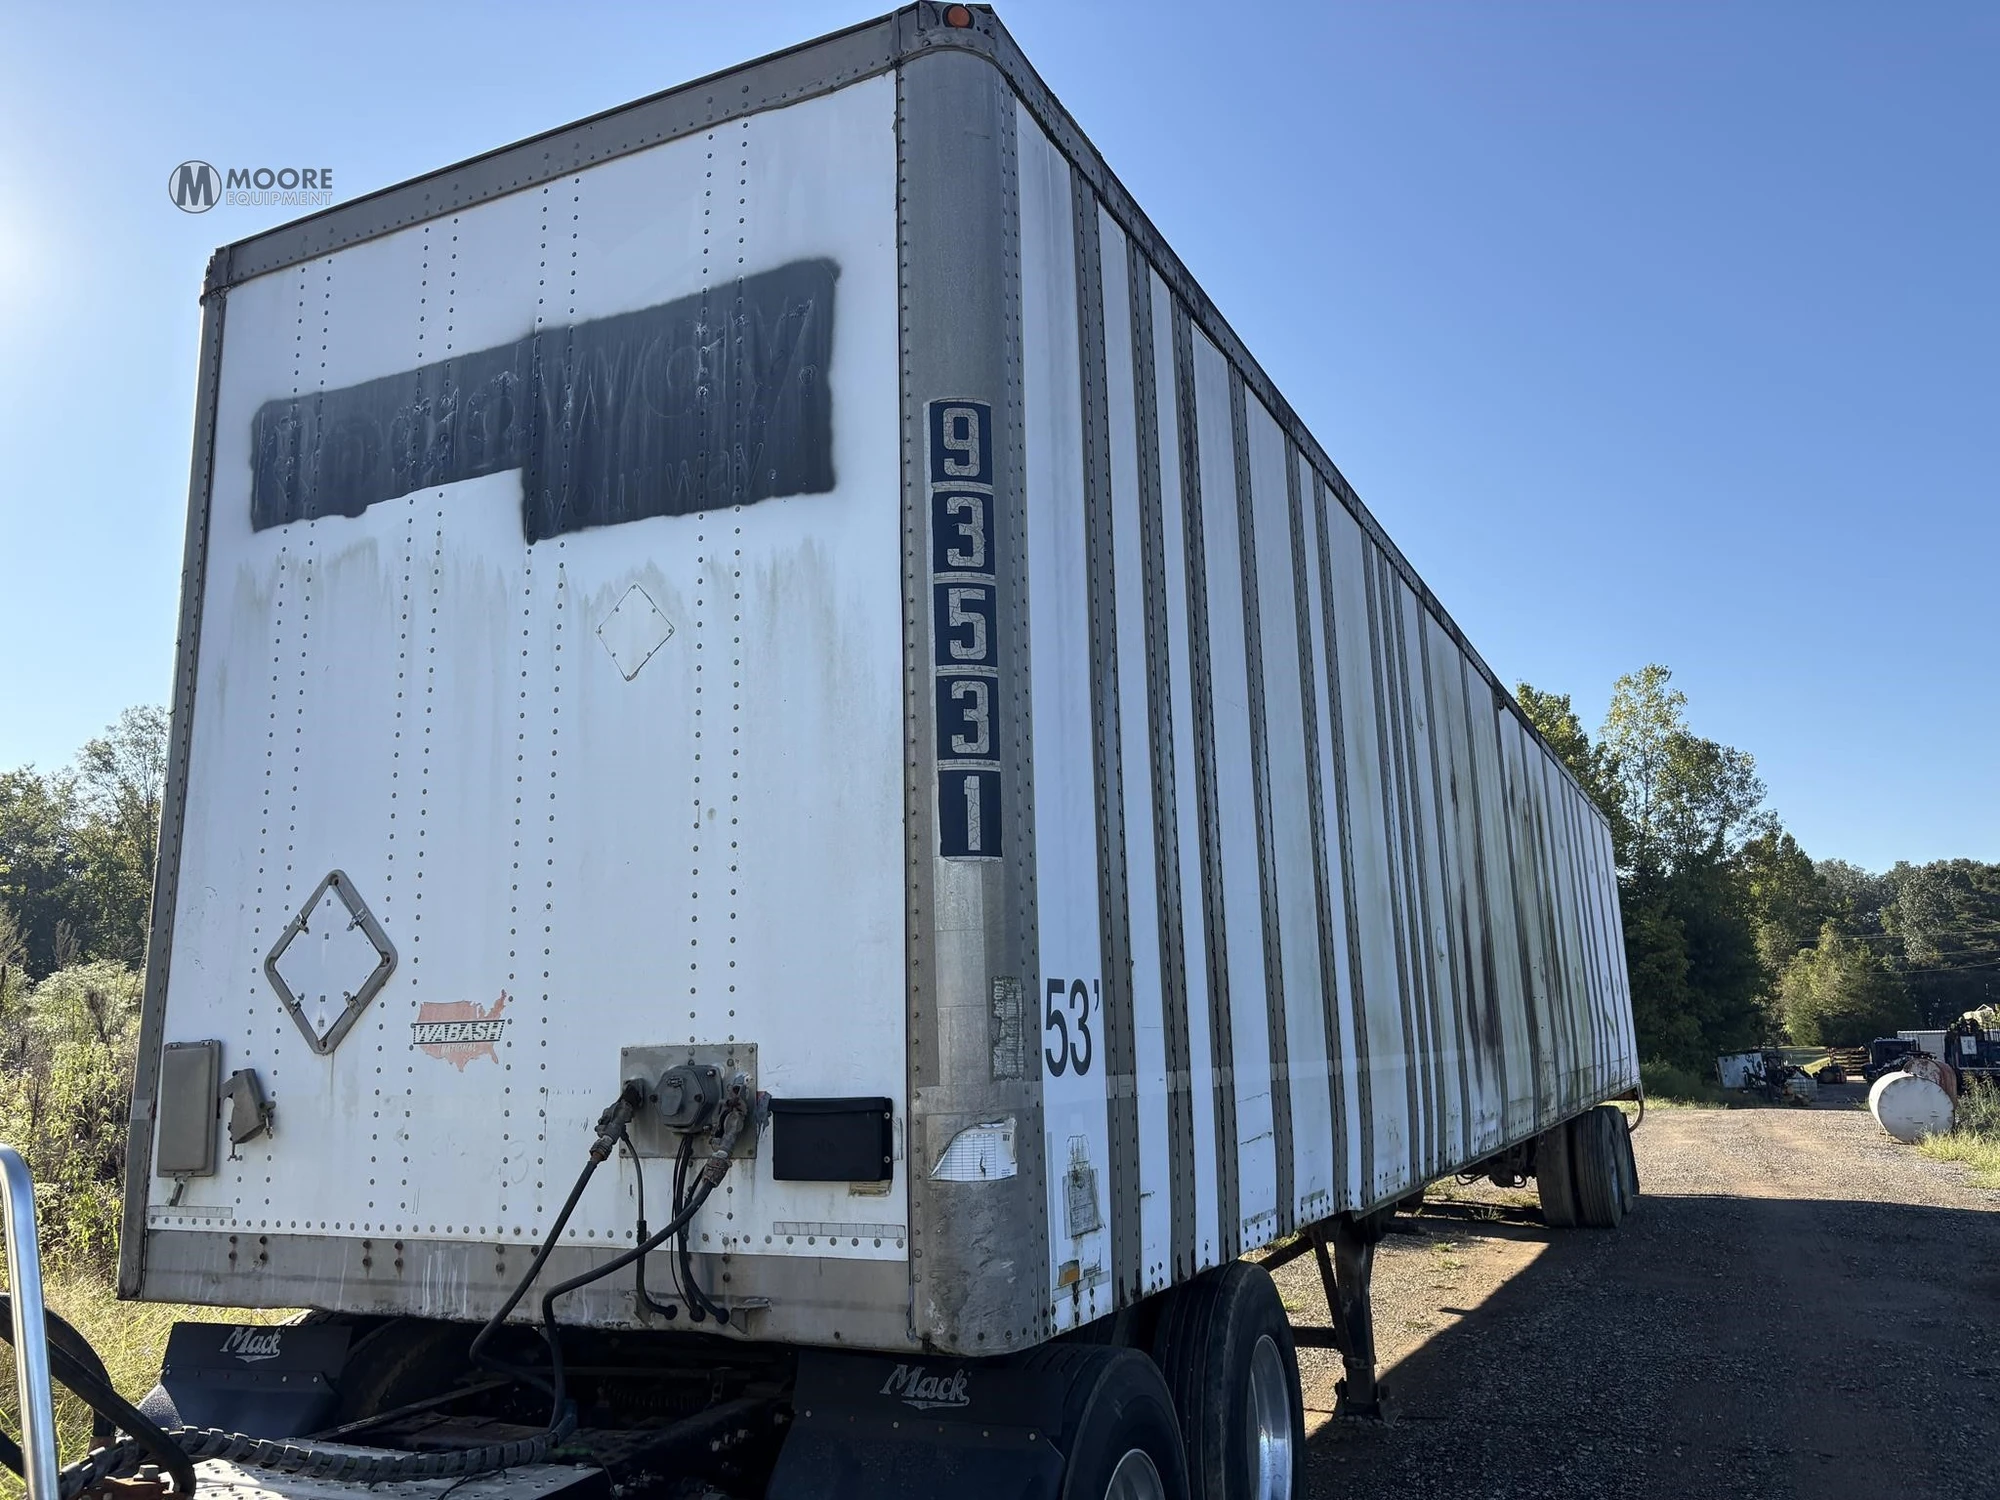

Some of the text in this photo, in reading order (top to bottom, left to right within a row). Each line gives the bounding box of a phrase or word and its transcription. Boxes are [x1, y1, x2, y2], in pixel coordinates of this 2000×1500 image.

[414, 1022, 503, 1042] WABASH
[220, 1326, 281, 1357] Mack
[879, 1364, 970, 1402] Mack
